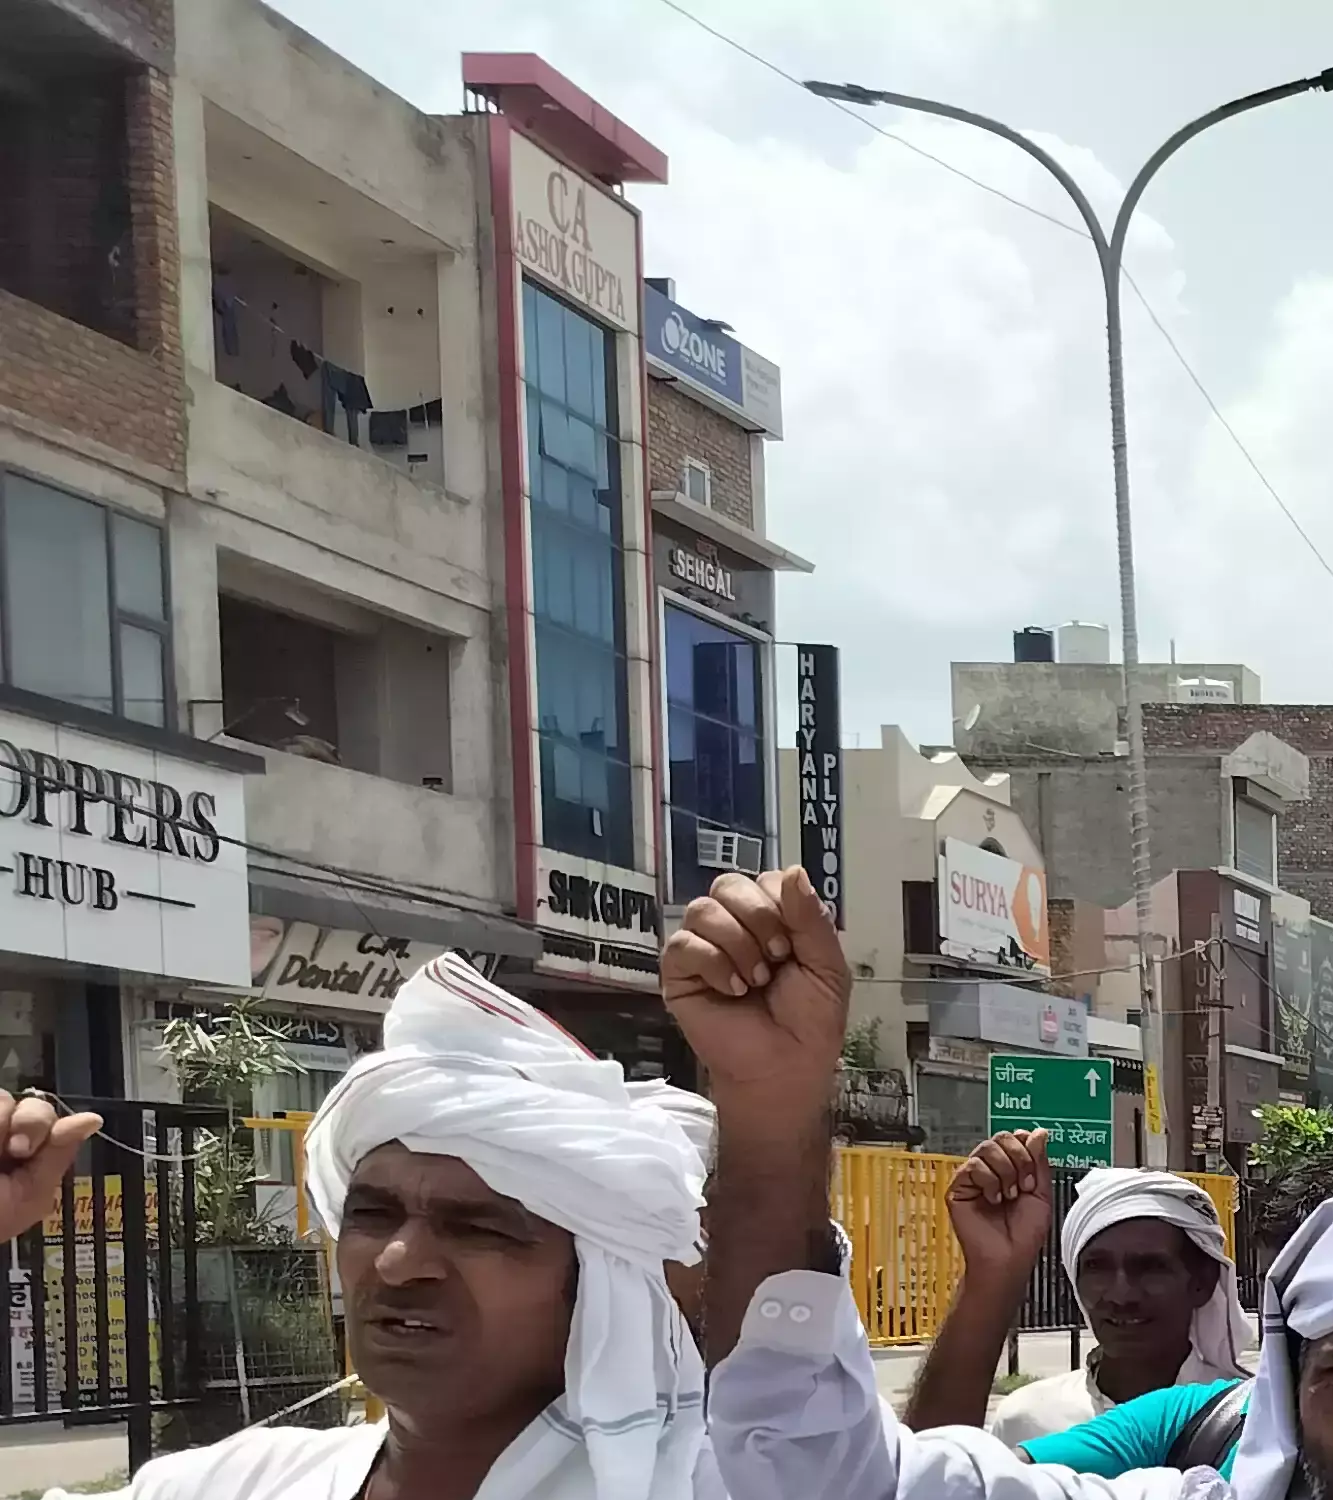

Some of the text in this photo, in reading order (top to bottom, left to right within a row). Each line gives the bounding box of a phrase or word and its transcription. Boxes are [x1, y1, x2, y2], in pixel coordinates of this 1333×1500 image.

[547, 170, 592, 251] CA
[515, 211, 627, 322] ASHOK GUPTA
[671, 547, 735, 601] SEHGAL
[800, 653, 819, 826] HARYANA
[18, 852, 118, 911] HUB
[951, 870, 1008, 920] SURYA
[277, 953, 374, 995] Dental
[995, 1062, 1035, 1084] जीन्द
[995, 1094, 1031, 1111] Jind
[1068, 1123, 1107, 1145] स्टेशन
